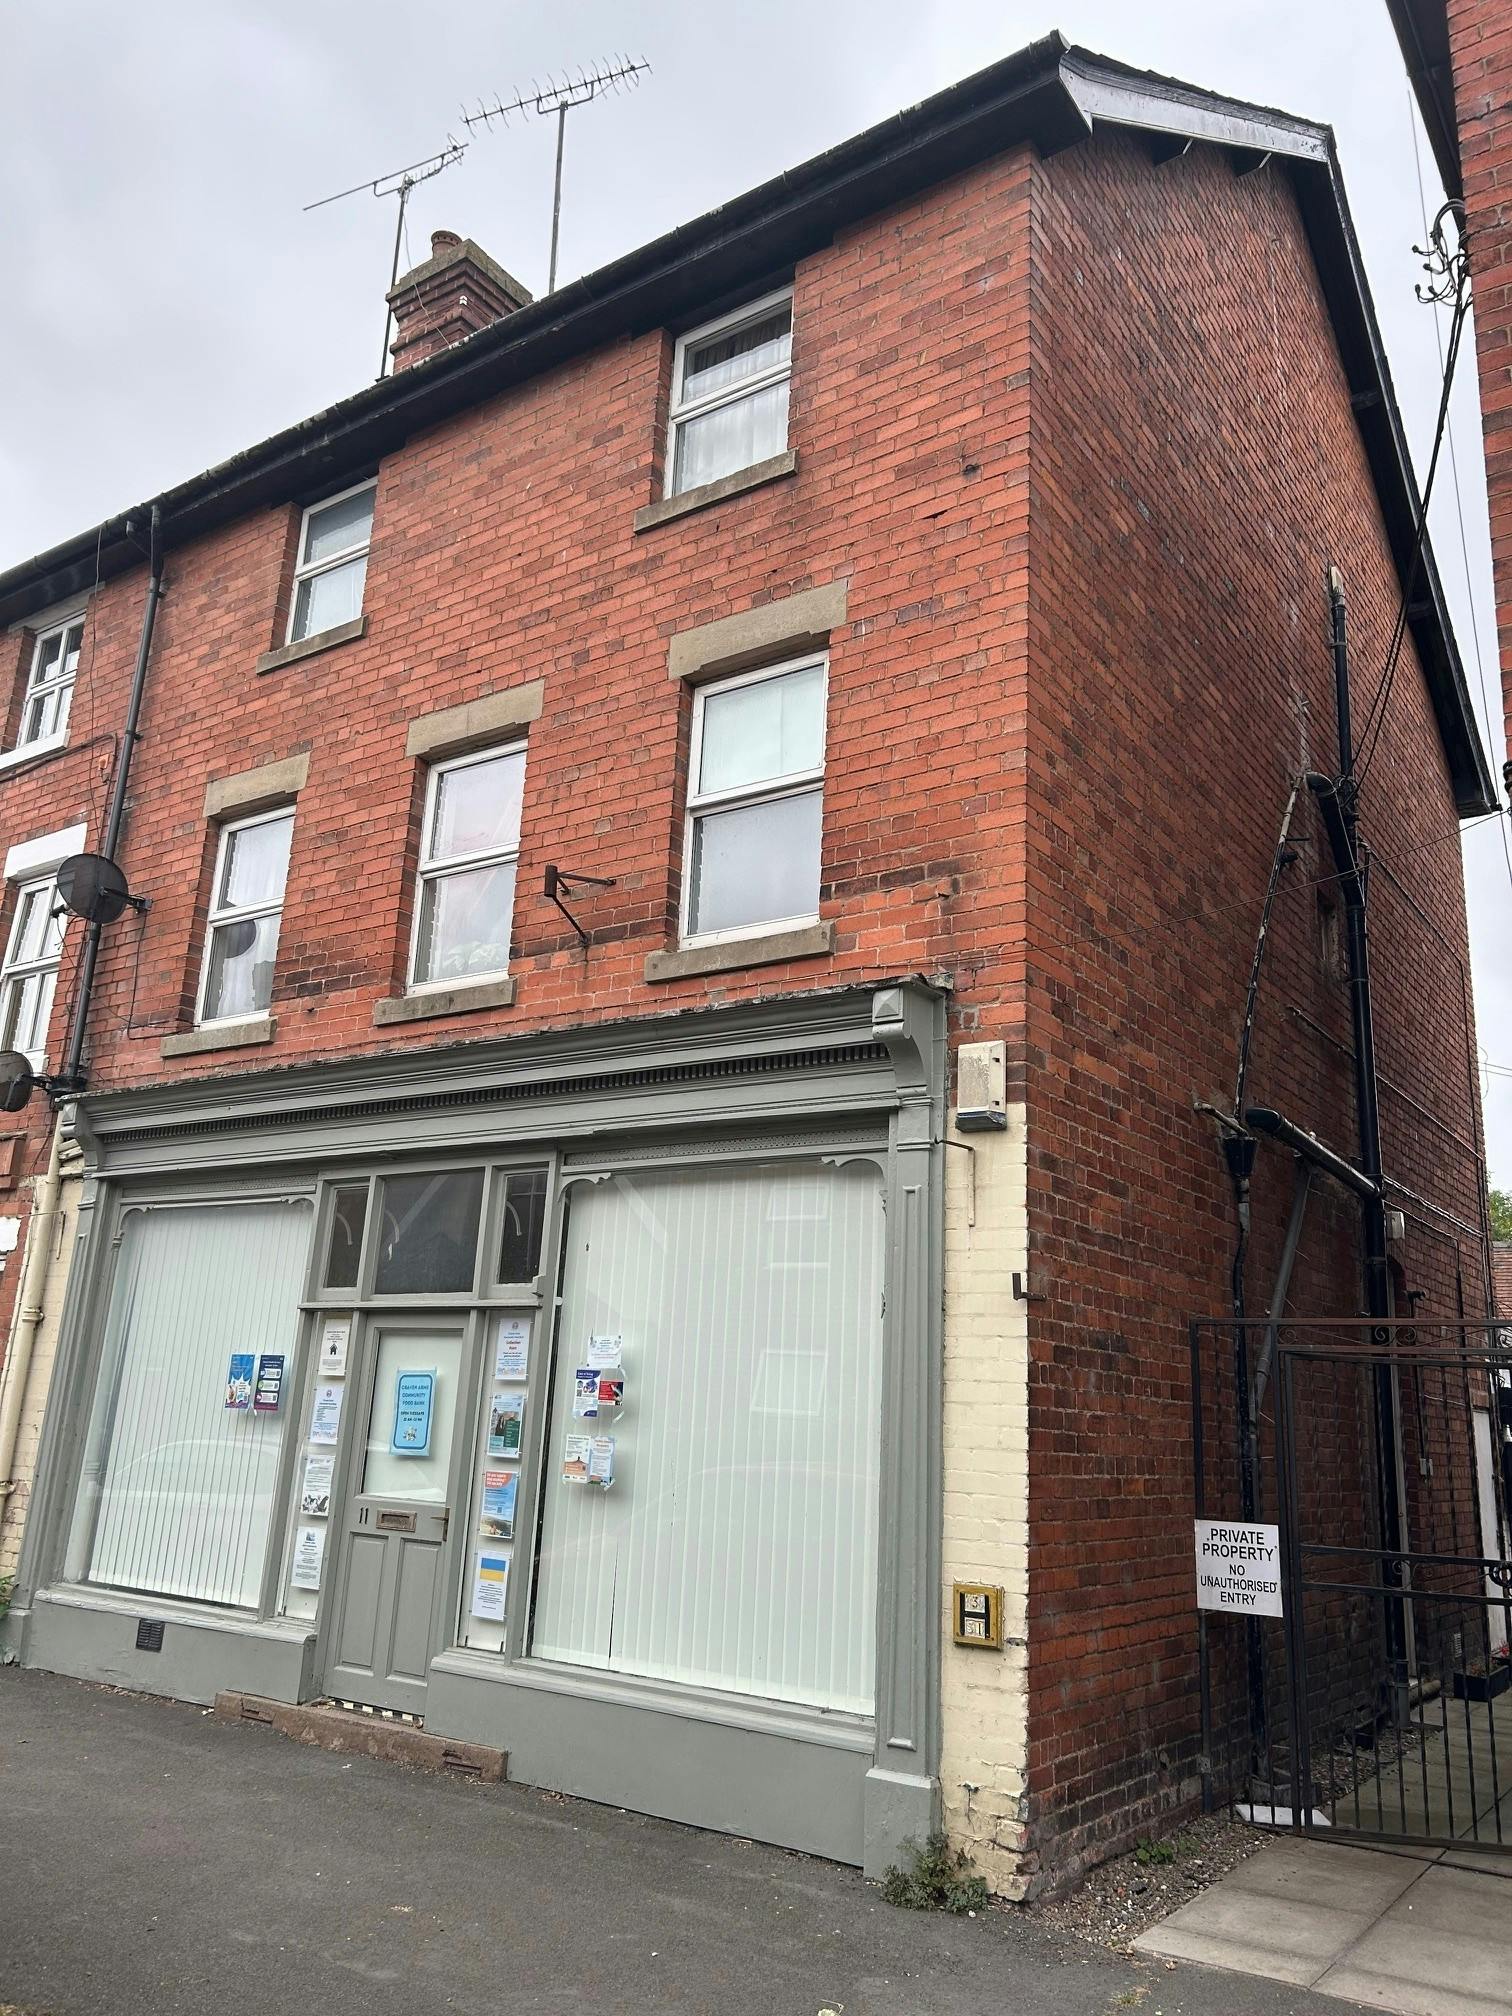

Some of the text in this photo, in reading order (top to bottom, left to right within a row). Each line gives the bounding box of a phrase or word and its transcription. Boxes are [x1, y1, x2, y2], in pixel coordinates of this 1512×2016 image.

[359, 1507, 369, 1525] 11
[1211, 1528, 1264, 1545] PRIVATE
[1203, 1543, 1273, 1561] PROPERTY
[1229, 1564, 1245, 1576] NO
[1200, 1575, 1277, 1593] UNAUTHORISED
[1220, 1591, 1256, 1605] ENTRY
